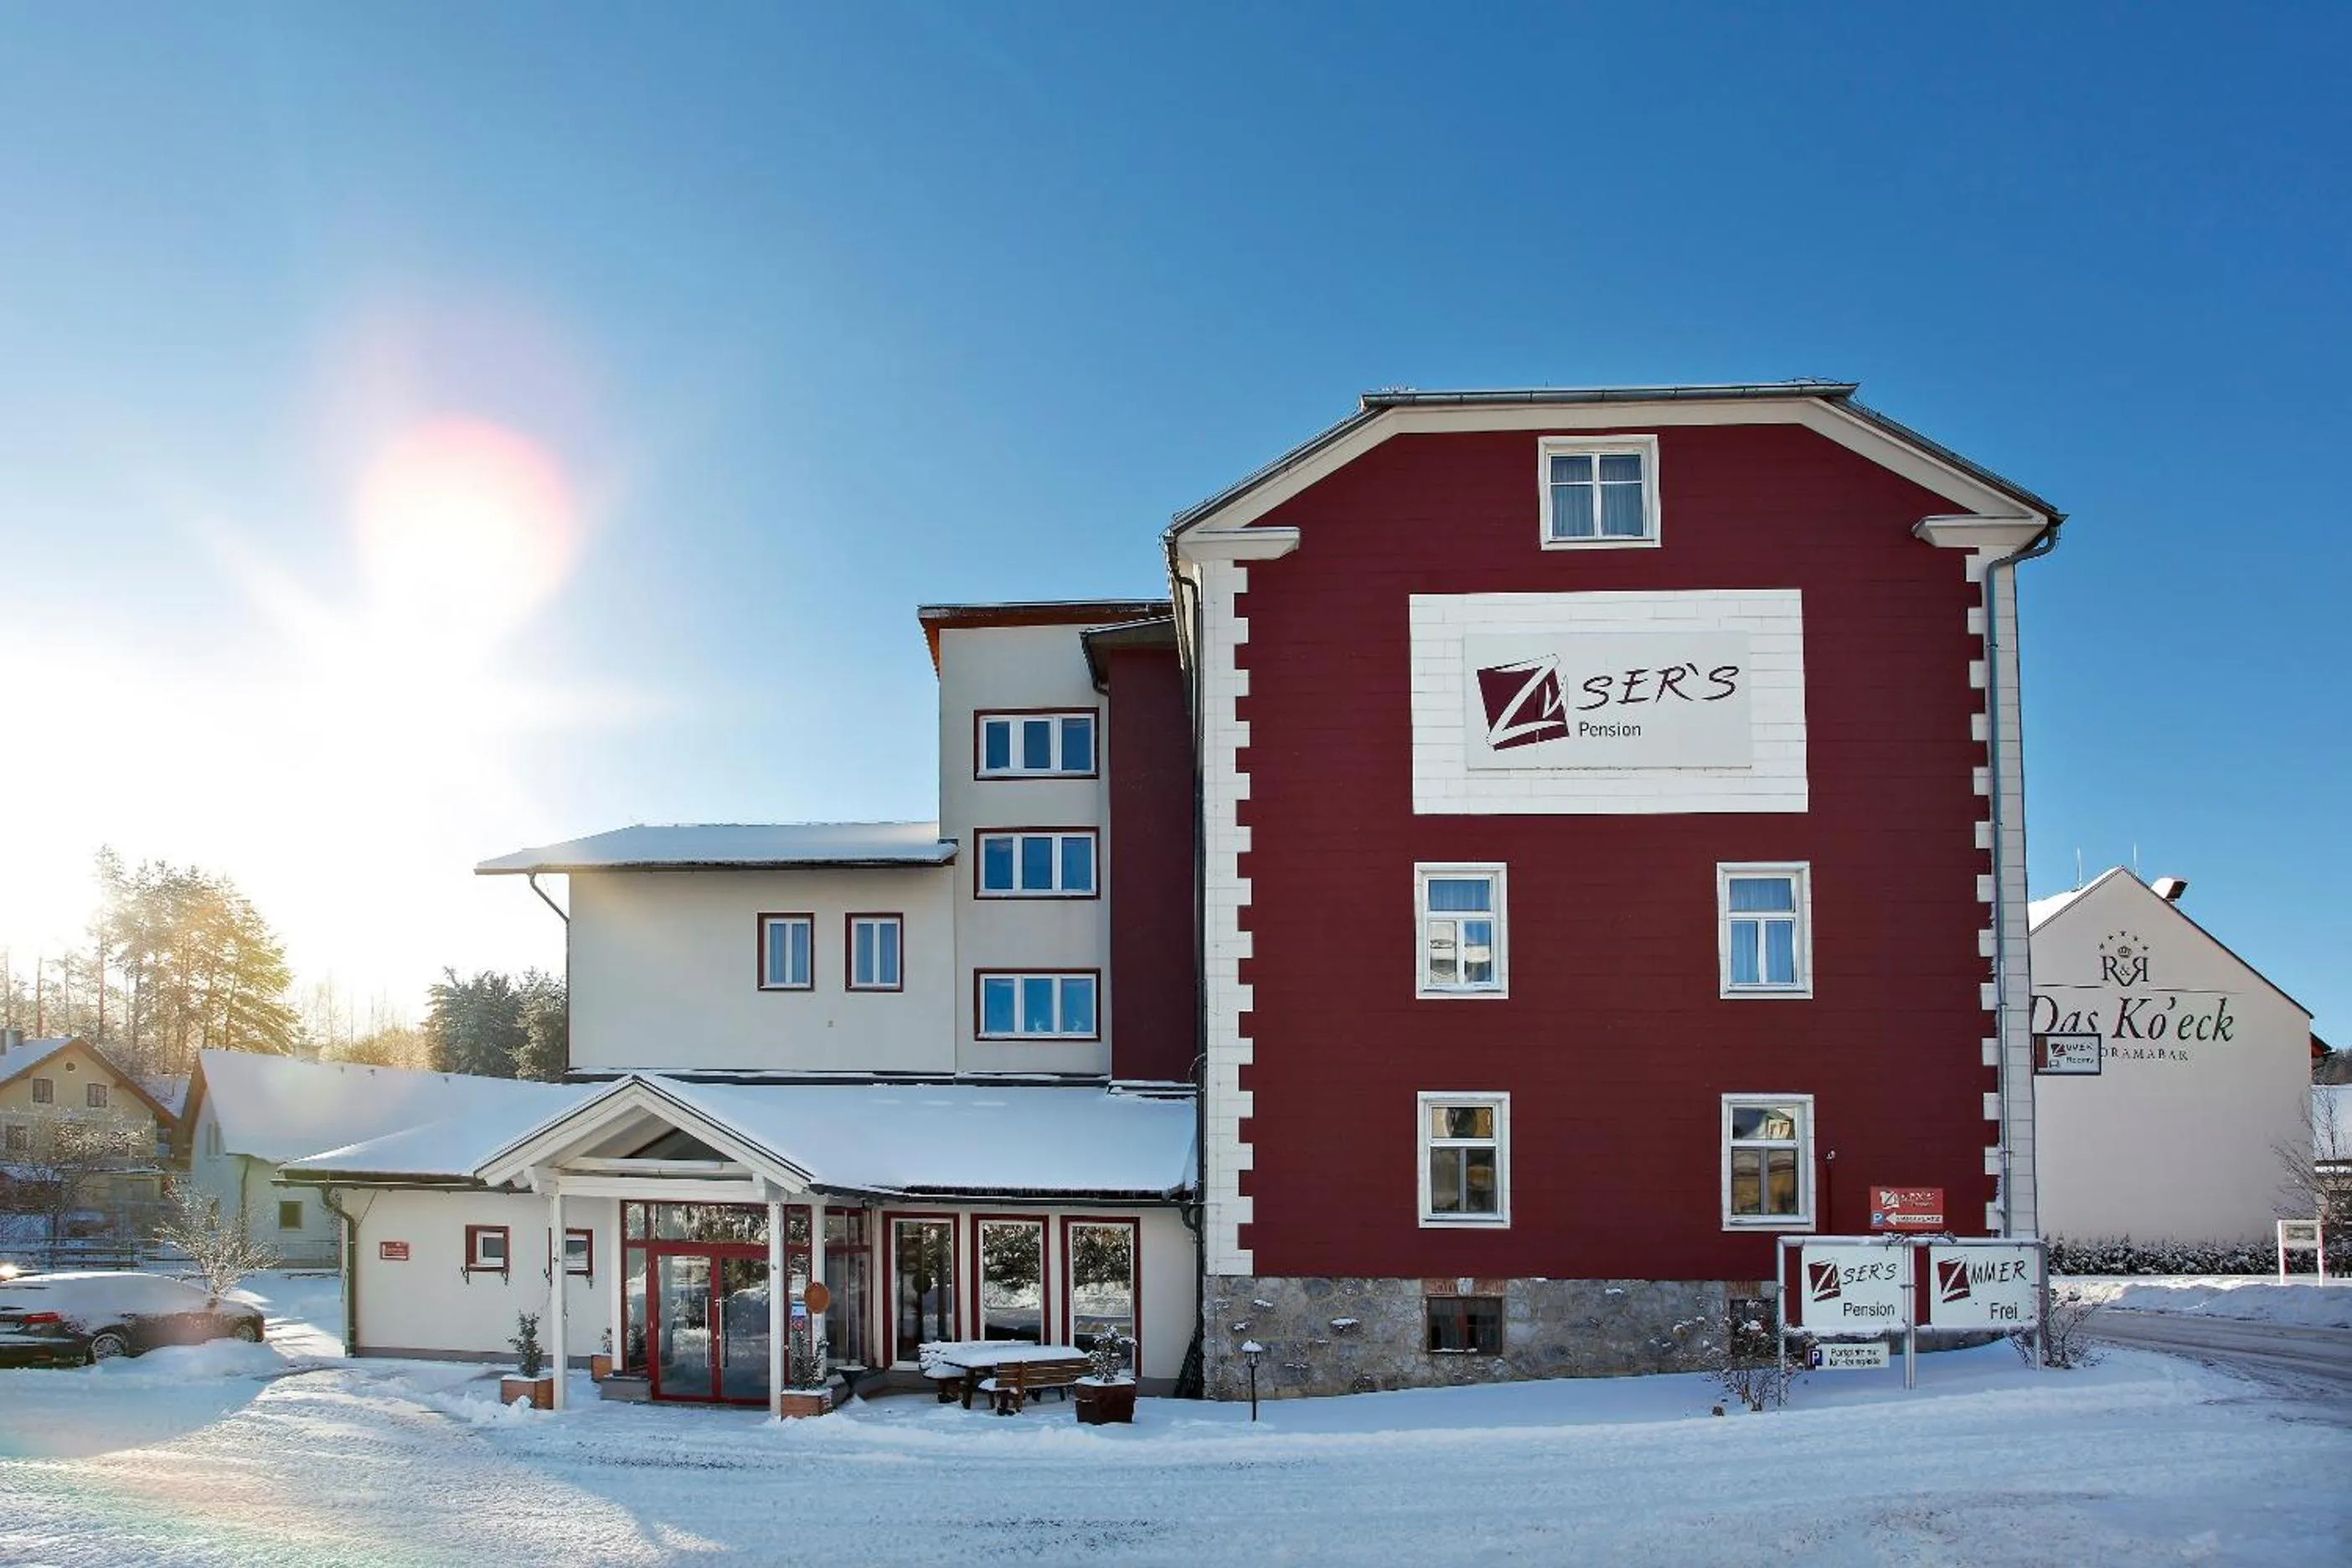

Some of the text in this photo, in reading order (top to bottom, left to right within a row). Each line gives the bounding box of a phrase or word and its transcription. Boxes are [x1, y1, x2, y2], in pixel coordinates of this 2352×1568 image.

[1579, 720, 1642, 737] Pension
[1844, 1301, 1896, 1317] Pension
[1989, 1302, 2018, 1319] Frei
